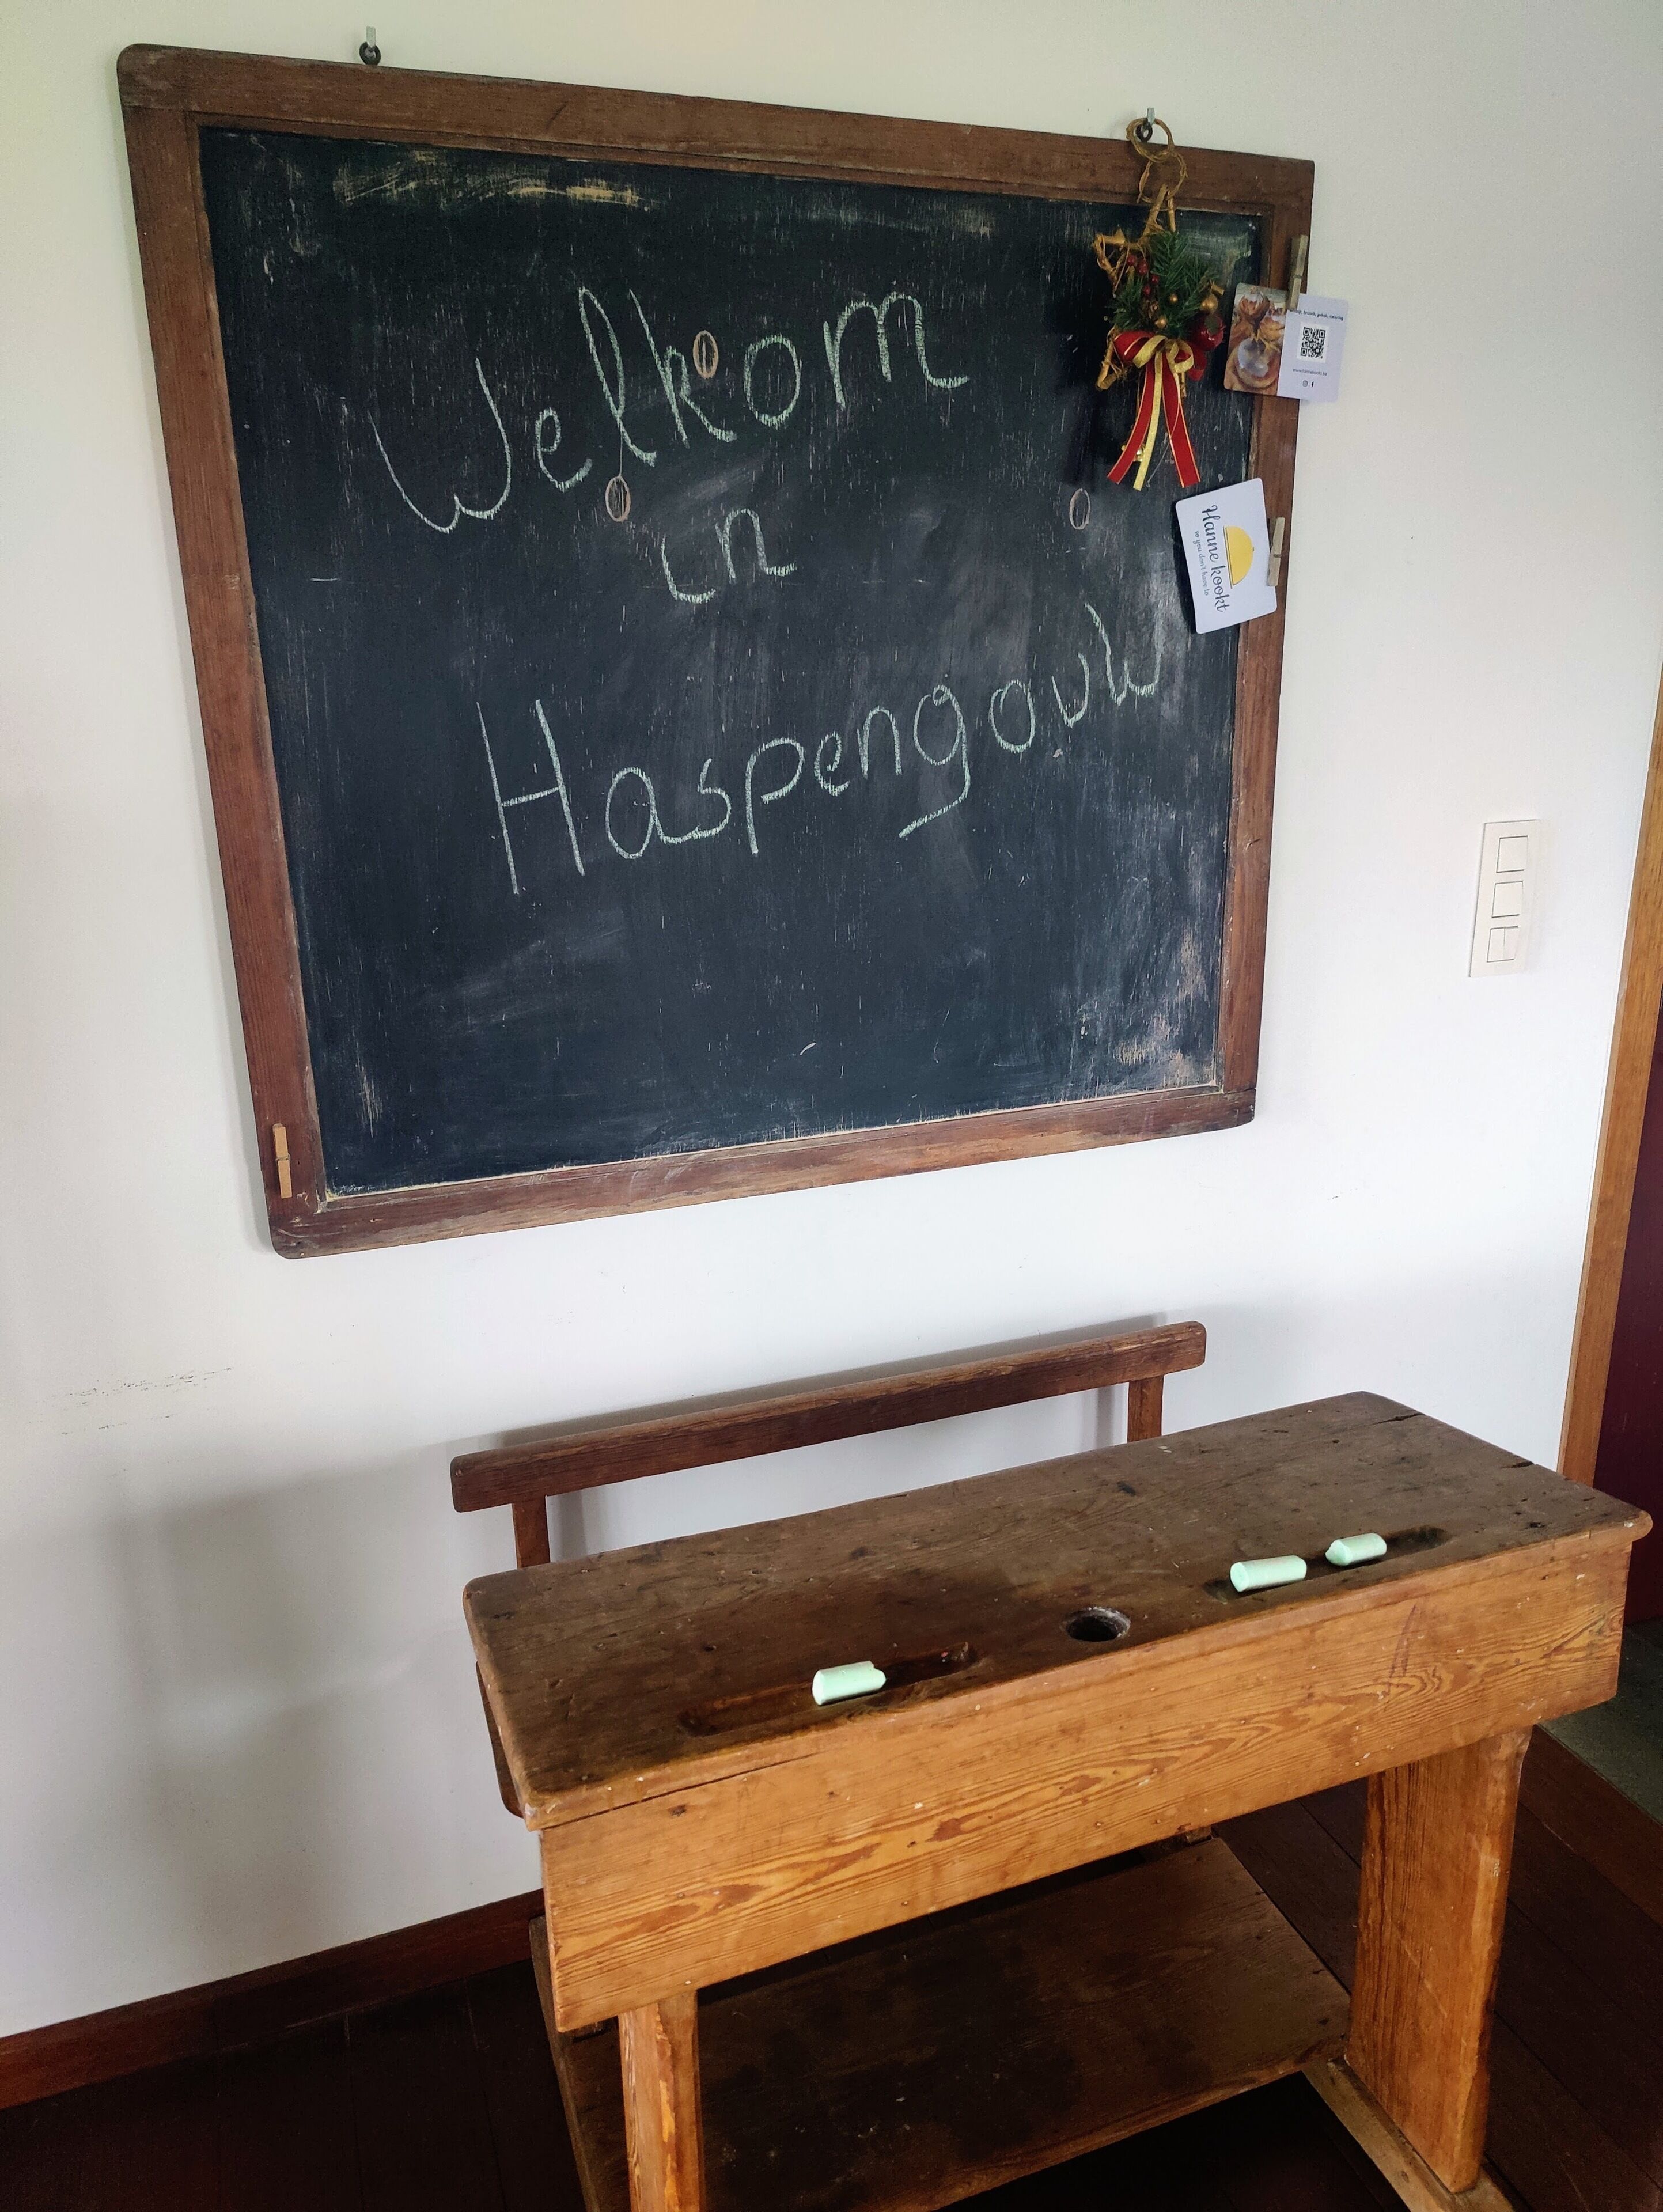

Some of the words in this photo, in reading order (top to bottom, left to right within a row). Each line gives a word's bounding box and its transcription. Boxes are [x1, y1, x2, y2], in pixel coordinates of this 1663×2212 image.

[367, 287, 970, 533] Welkom
[659, 507, 797, 604] in
[1192, 539, 1202, 552] you
[1202, 505, 1221, 563] Hanne
[1210, 565, 1230, 612] kookt
[476, 603, 1164, 896] Haspengouw
